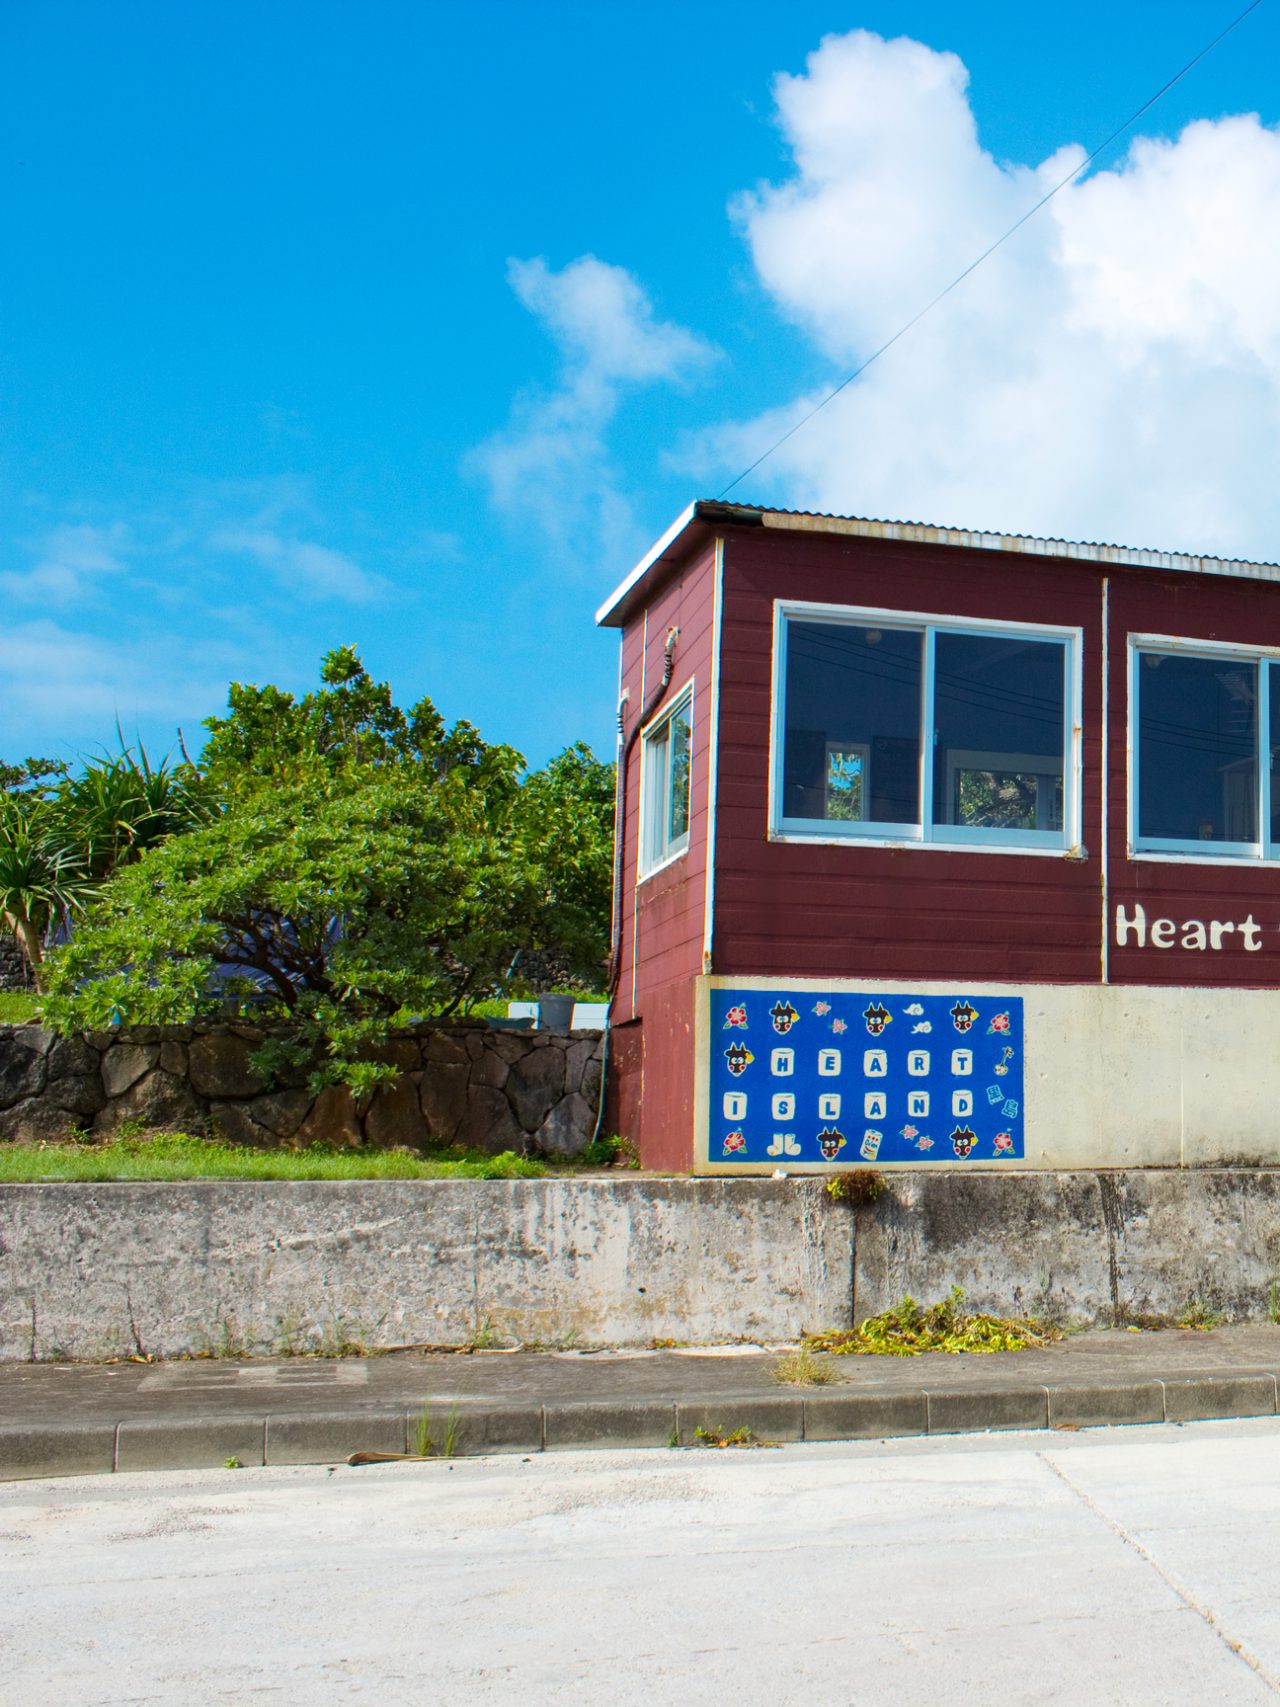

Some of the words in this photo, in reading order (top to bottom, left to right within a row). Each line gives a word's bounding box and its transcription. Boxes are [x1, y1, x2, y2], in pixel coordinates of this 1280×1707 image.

[1116, 904, 1262, 951] Heart
[776, 1056, 968, 1072] HEART
[731, 1098, 968, 1117] ISLAND
